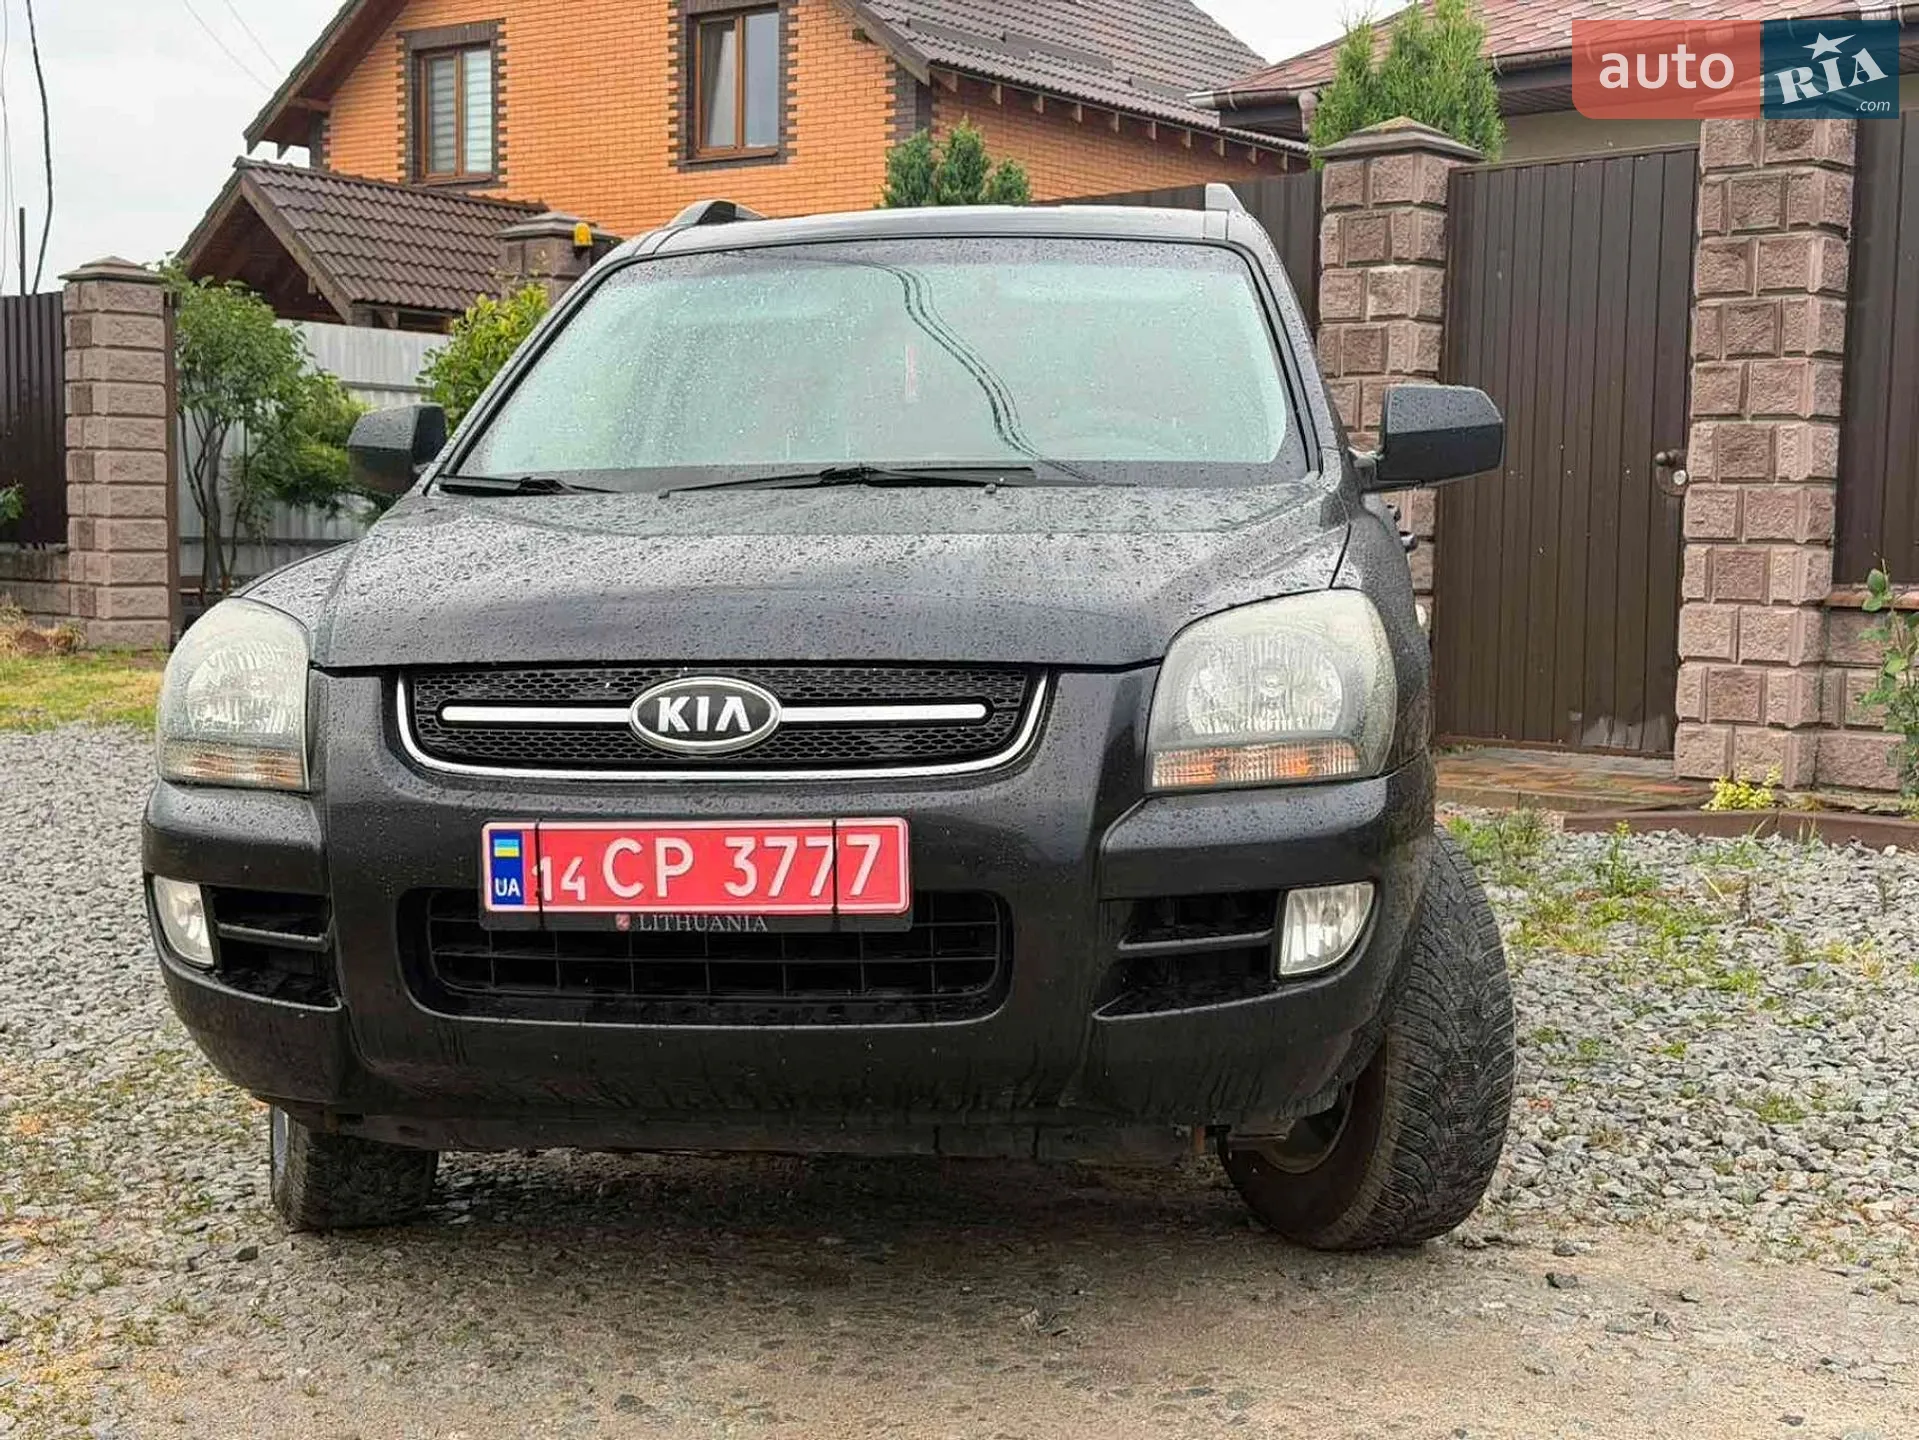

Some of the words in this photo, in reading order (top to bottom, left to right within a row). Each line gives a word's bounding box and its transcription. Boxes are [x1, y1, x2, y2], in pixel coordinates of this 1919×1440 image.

[657, 696, 751, 732] KIA
[531, 856, 586, 901] 14
[723, 834, 882, 898] 3777
[495, 878, 520, 898] UA
[637, 914, 769, 933] LITHUANIA
